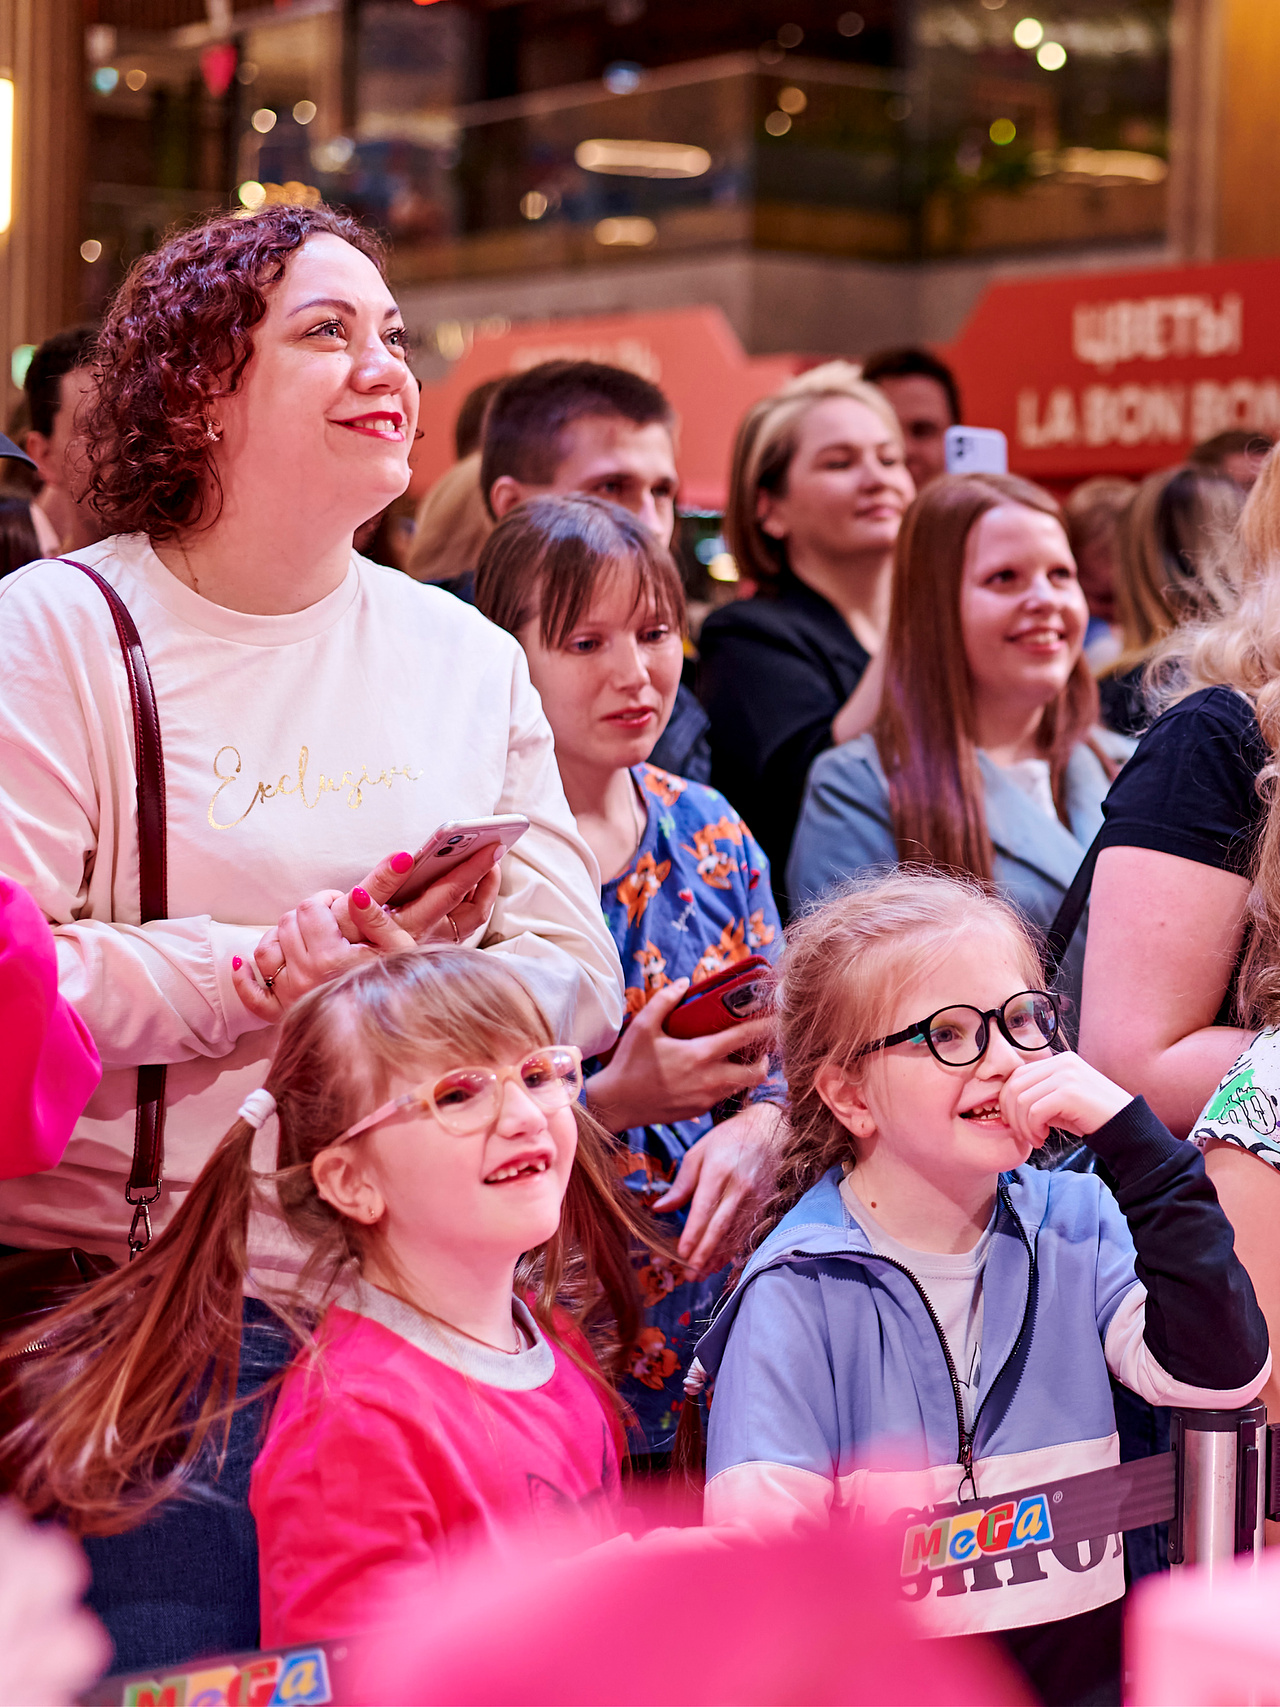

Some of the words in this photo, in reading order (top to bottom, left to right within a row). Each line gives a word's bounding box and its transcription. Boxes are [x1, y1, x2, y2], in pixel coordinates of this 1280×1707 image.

[1072, 294, 1243, 372] ЦВЕТЫ
[1016, 386, 1077, 448] LA
[1083, 382, 1185, 447] BON
[208, 745, 424, 830] Exclusive
